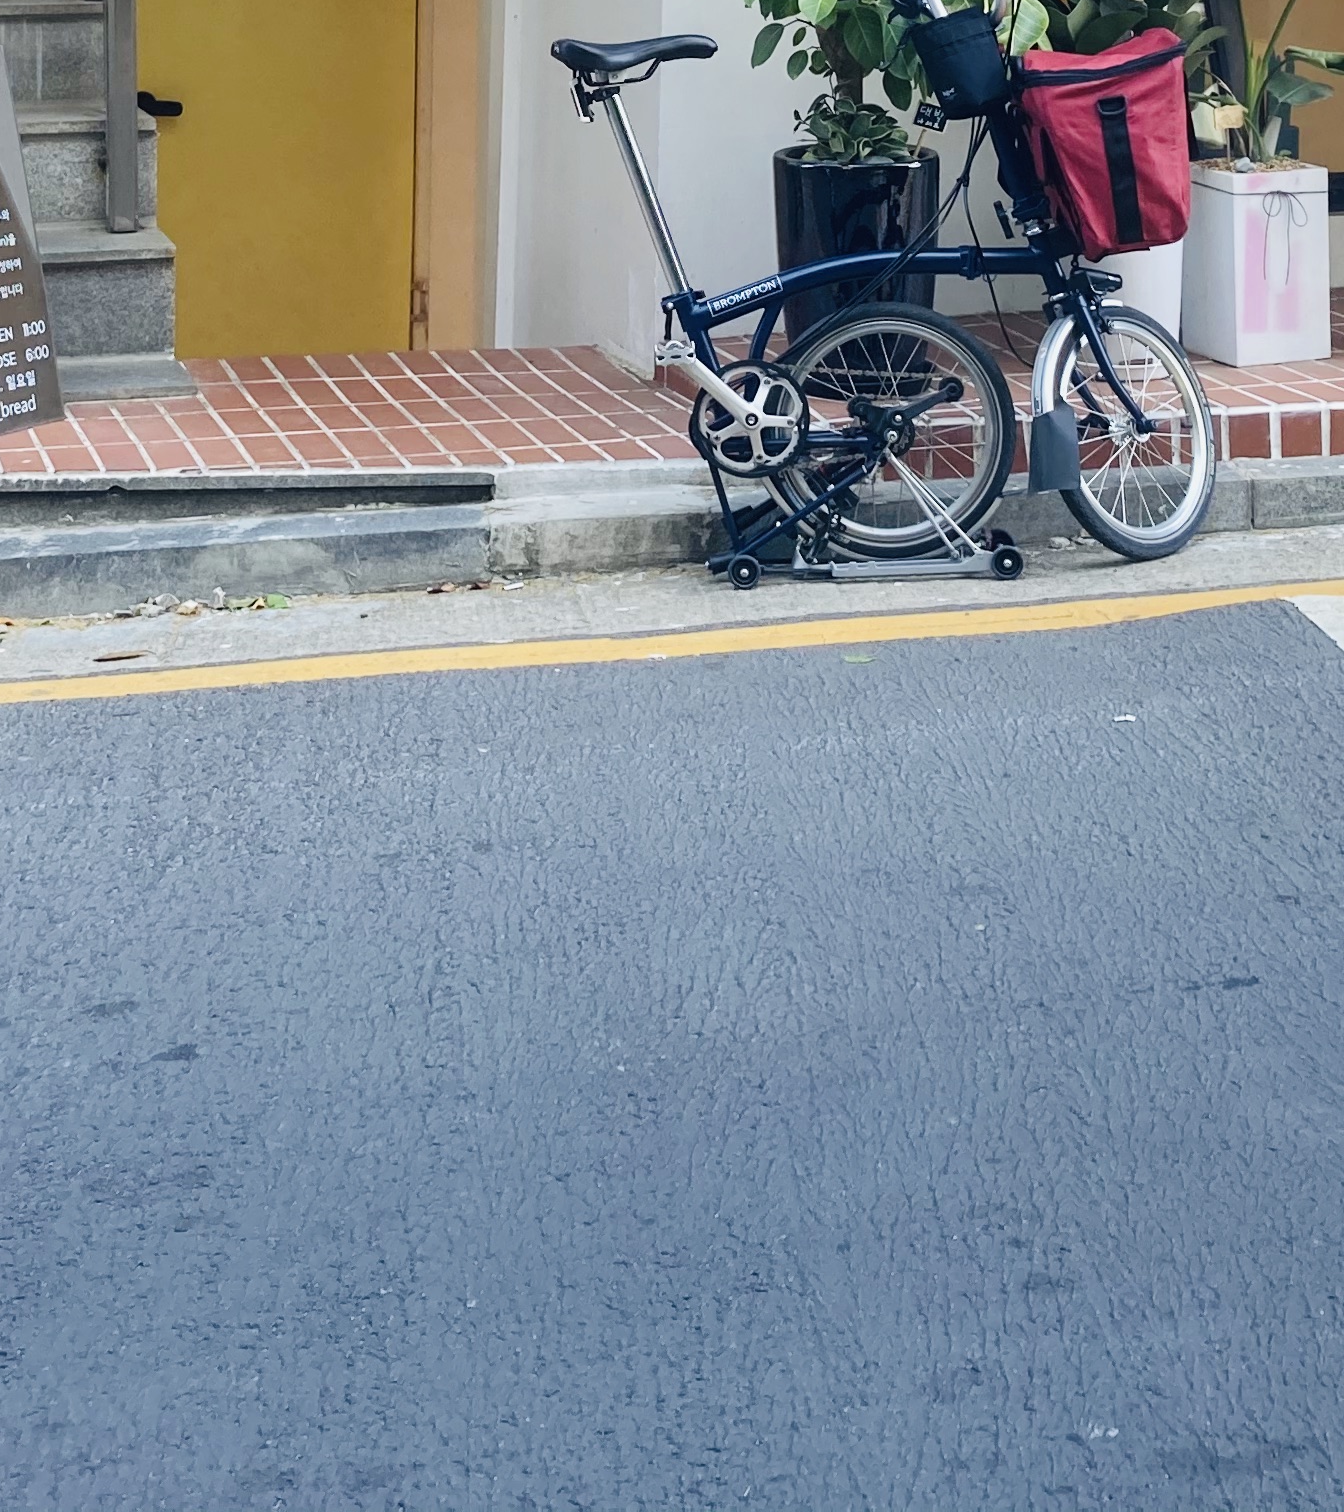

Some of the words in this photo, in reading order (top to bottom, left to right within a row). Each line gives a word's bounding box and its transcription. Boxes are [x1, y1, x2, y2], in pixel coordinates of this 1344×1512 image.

[712, 279, 777, 311] BROMPTON
[22, 320, 46, 337] 11:00
[25, 344, 49, 362] 6:00
[6, 370, 36, 391] 일요일
